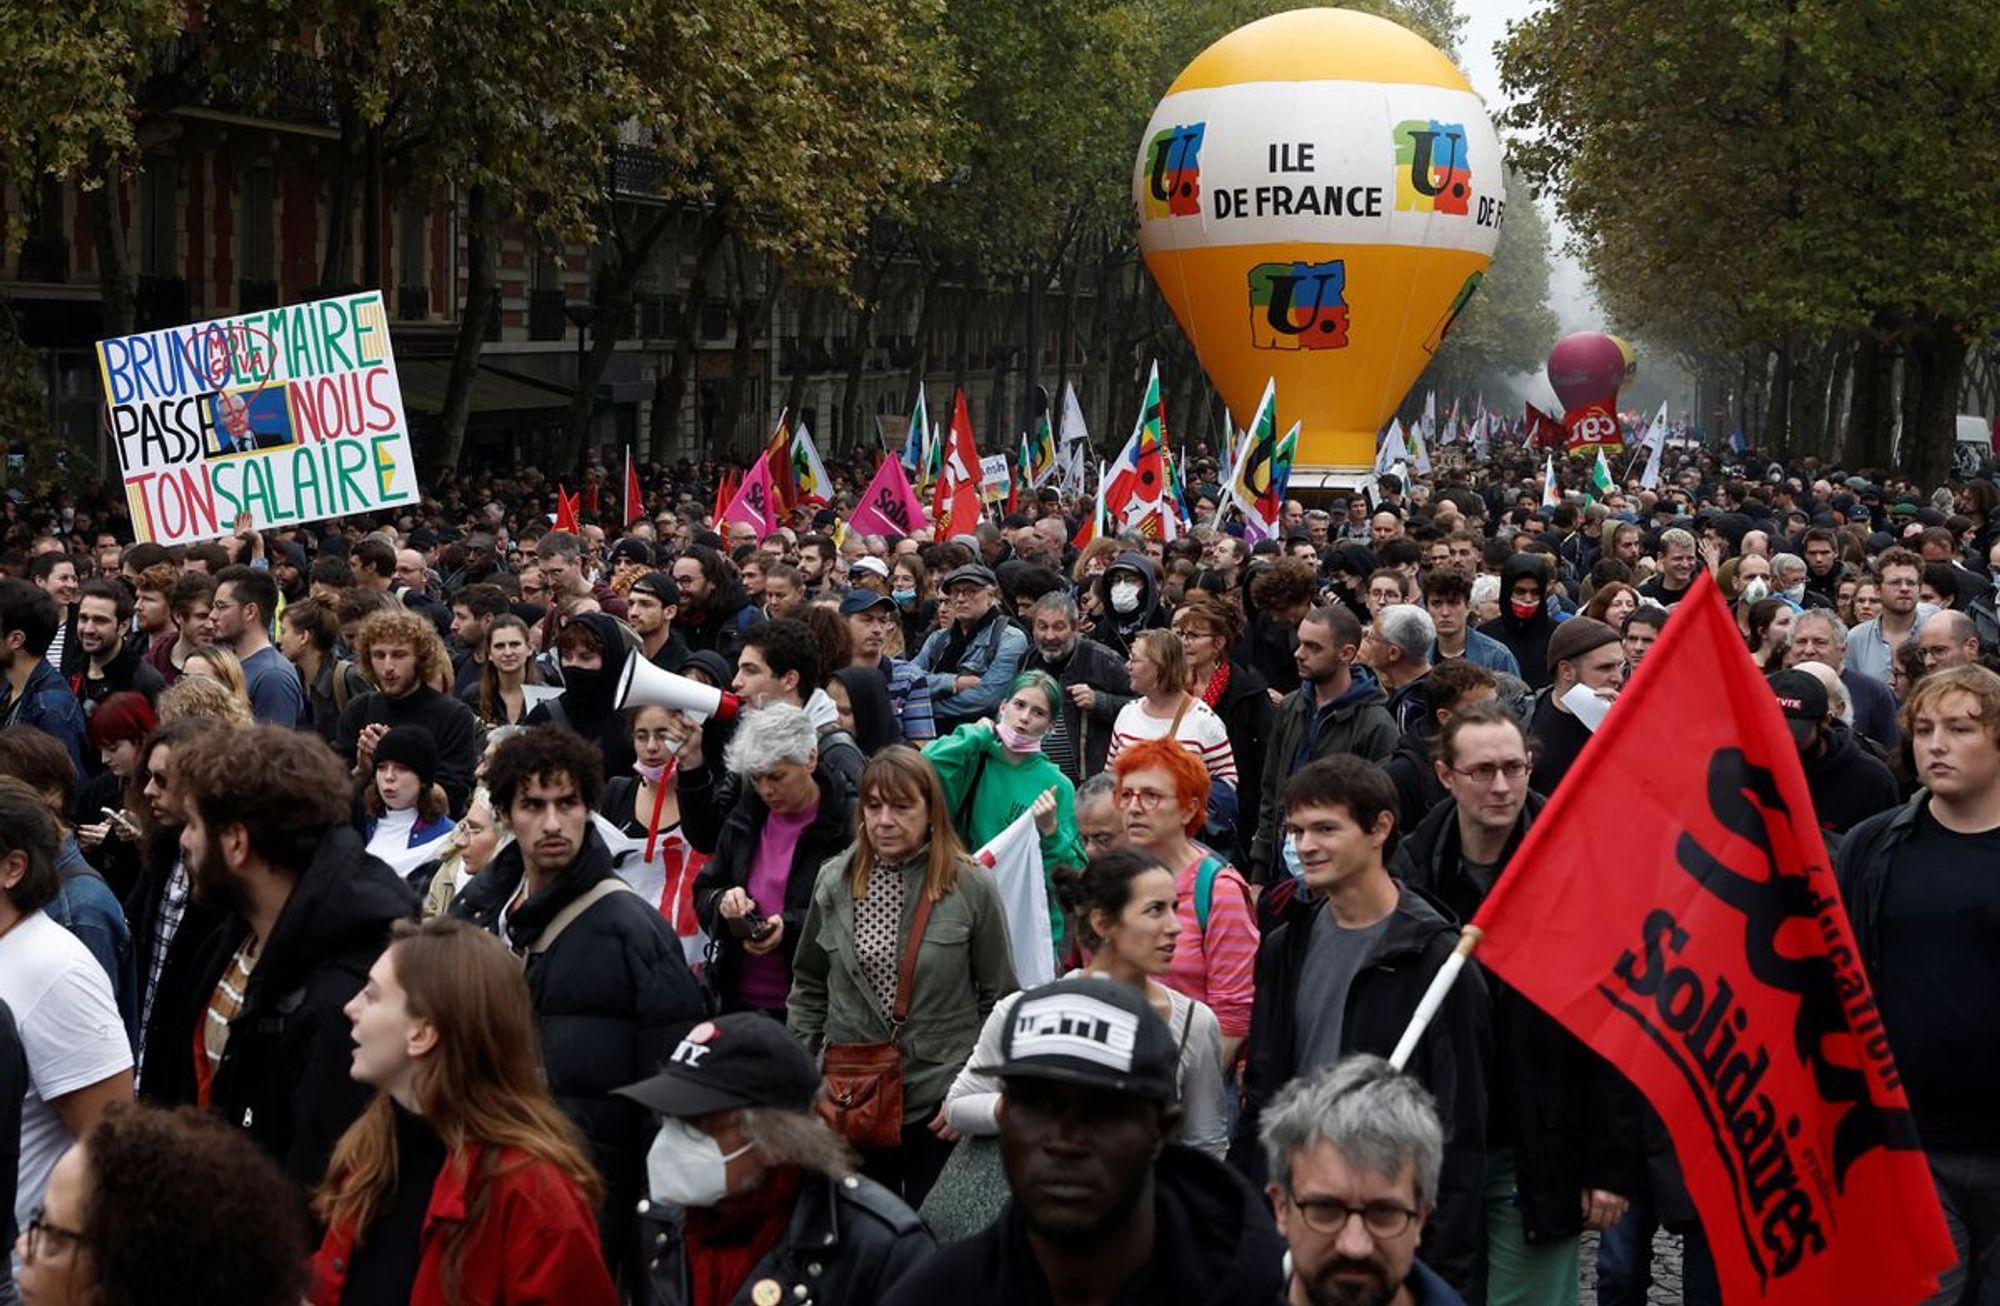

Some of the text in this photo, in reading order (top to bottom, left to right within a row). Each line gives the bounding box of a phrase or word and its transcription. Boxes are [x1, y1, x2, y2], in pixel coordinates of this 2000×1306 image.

[1268, 143, 1315, 173] ILE
[1214, 185, 1382, 219] DE FRANCE
[1477, 195, 1495, 227] DE
[102, 322, 231, 403] BRUNO
[112, 367, 396, 470] PASSE NOUS
[125, 464, 219, 543] TON
[1803, 865, 1901, 1092] ducation
[1614, 909, 1827, 1278] Solidaires
